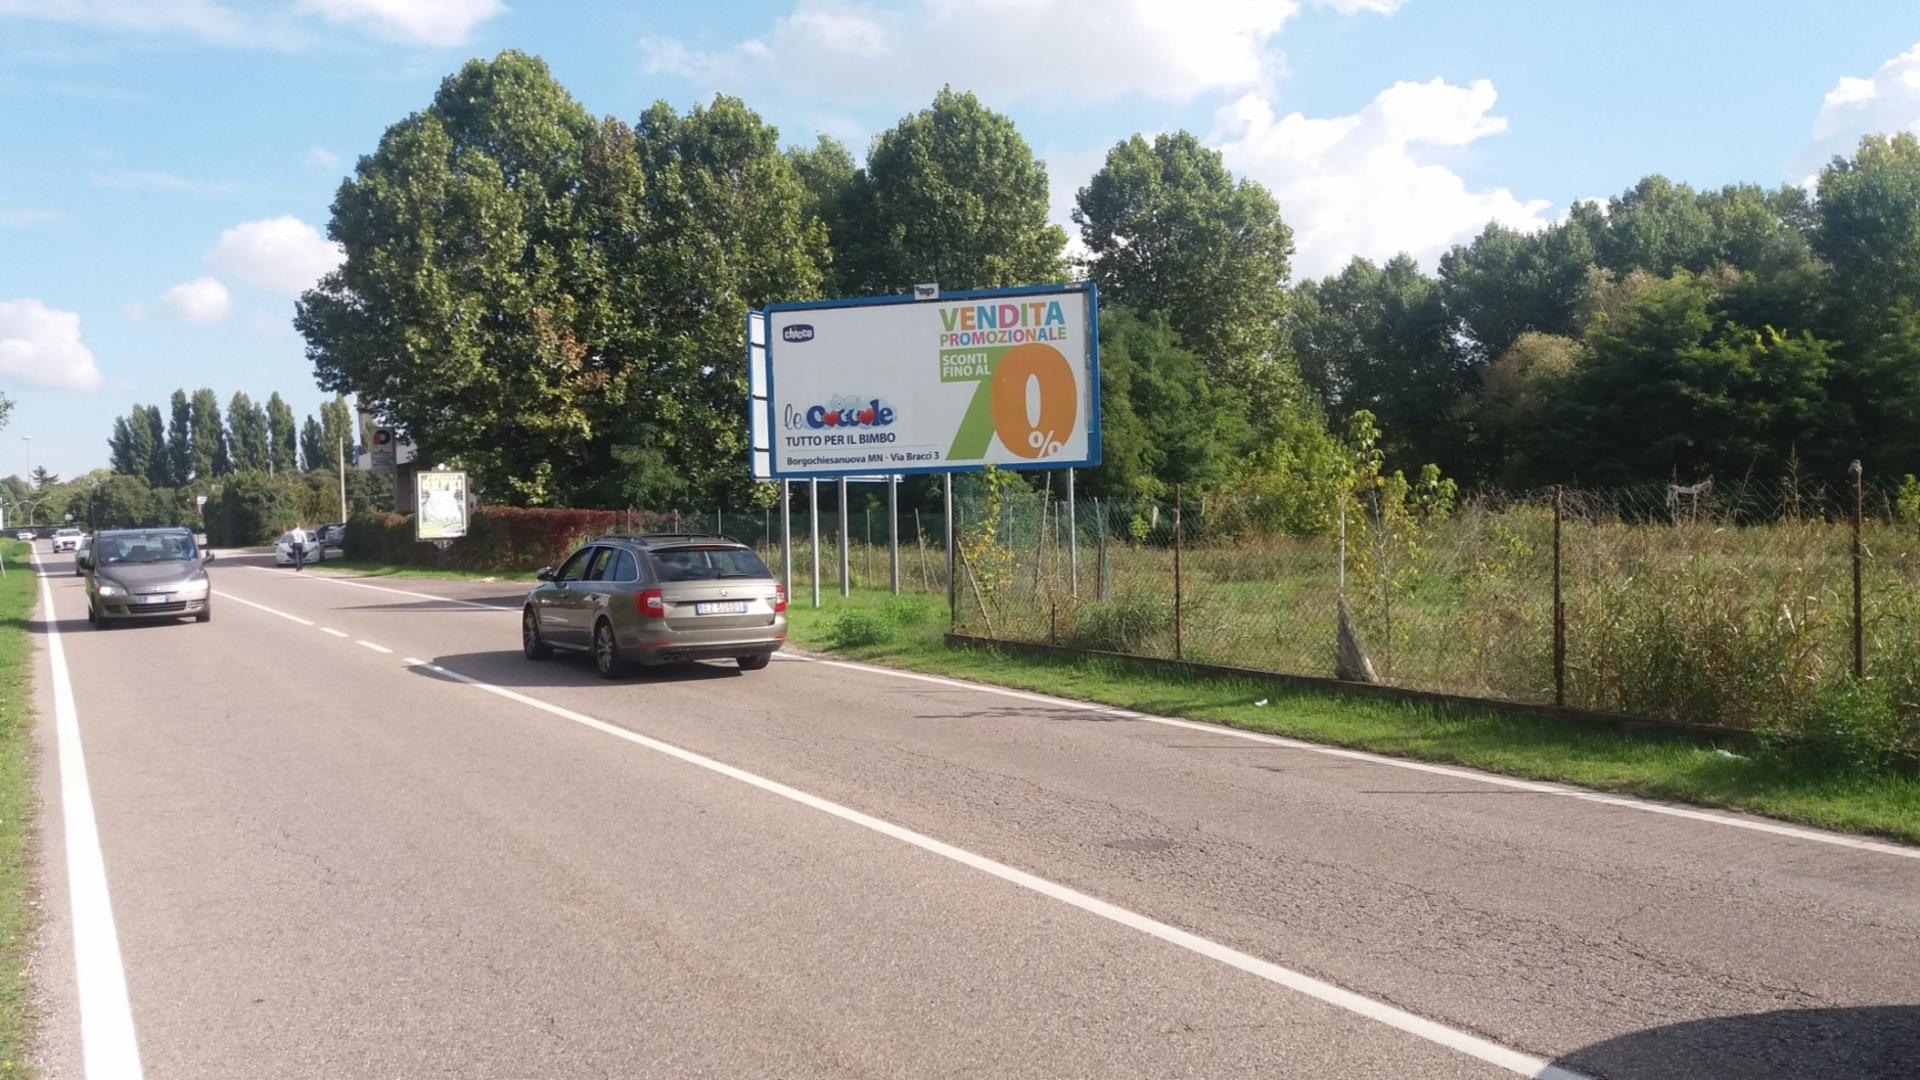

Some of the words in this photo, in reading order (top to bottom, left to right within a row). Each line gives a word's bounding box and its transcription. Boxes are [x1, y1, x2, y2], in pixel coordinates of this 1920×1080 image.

[939, 301, 1064, 331] VENDITA
[940, 327, 1066, 346] PROMOZIONALE
[942, 353, 988, 366] SCONTI
[943, 366, 973, 377] FINO
[975, 365, 992, 376] AL
[786, 435, 821, 447] TUTTO
[824, 434, 845, 445] PER
[847, 433, 857, 444] IL
[859, 432, 896, 444] BIMBO
[787, 456, 866, 467] Borgochiesanuova
[868, 453, 883, 462] MN
[890, 452, 904, 461] Via
[906, 451, 932, 461] Bracci
[934, 451, 940, 460] 3
